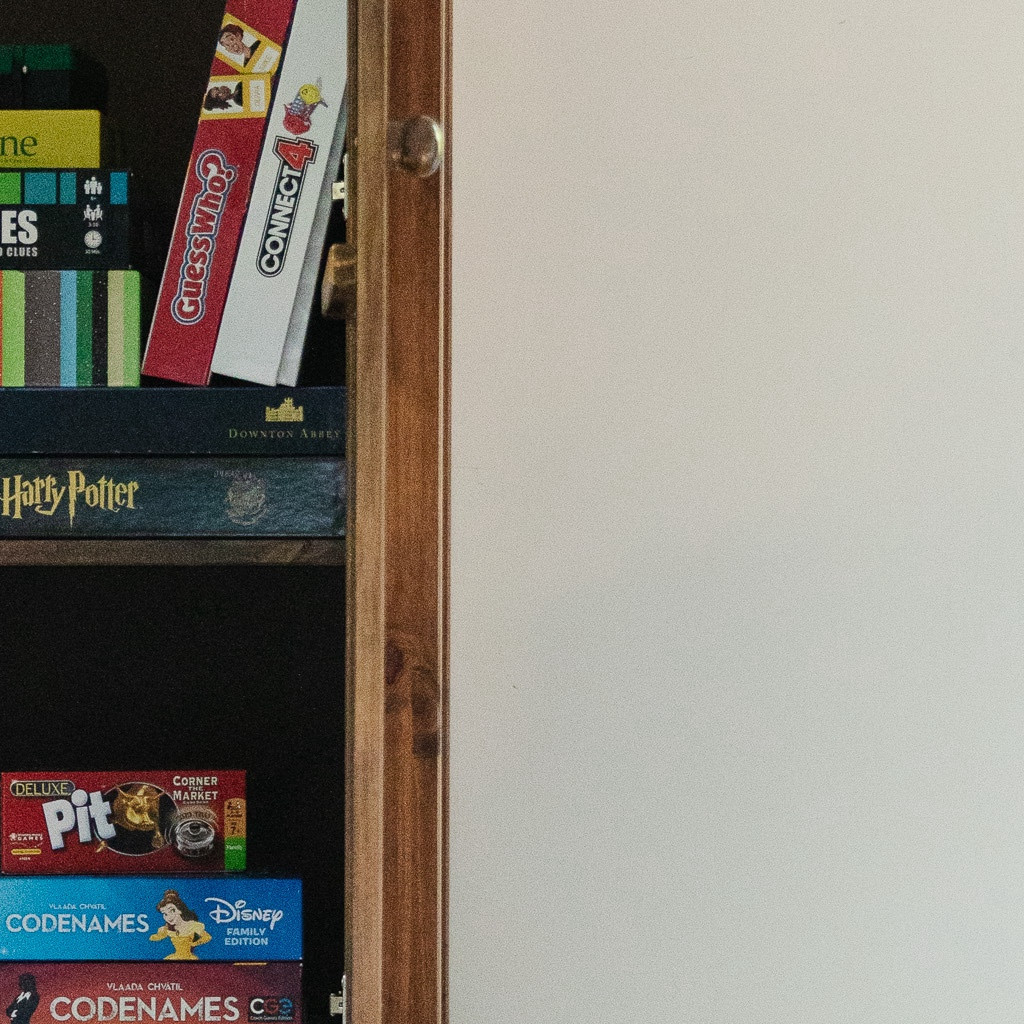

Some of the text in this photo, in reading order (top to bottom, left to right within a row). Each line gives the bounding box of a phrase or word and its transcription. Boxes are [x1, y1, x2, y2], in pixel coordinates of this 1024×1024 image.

[260, 138, 317, 275] CONNECT 4
[175, 151, 236, 323] Guess Who?
[6, 247, 38, 257] CLUES
[229, 428, 341, 439] DOWNTON ABBEY
[65, 470, 140, 528] Potter
[173, 776, 218, 786] CORNER
[15, 782, 73, 796] DELUXE
[173, 790, 218, 800] MARKET
[42, 789, 117, 850] Pit
[5, 913, 149, 933] CODENAMES
[226, 927, 266, 937] FAMILY
[224, 937, 269, 946] EDITION
[106, 983, 143, 991] VLAADA
[50, 996, 240, 1022] CODENAMES
